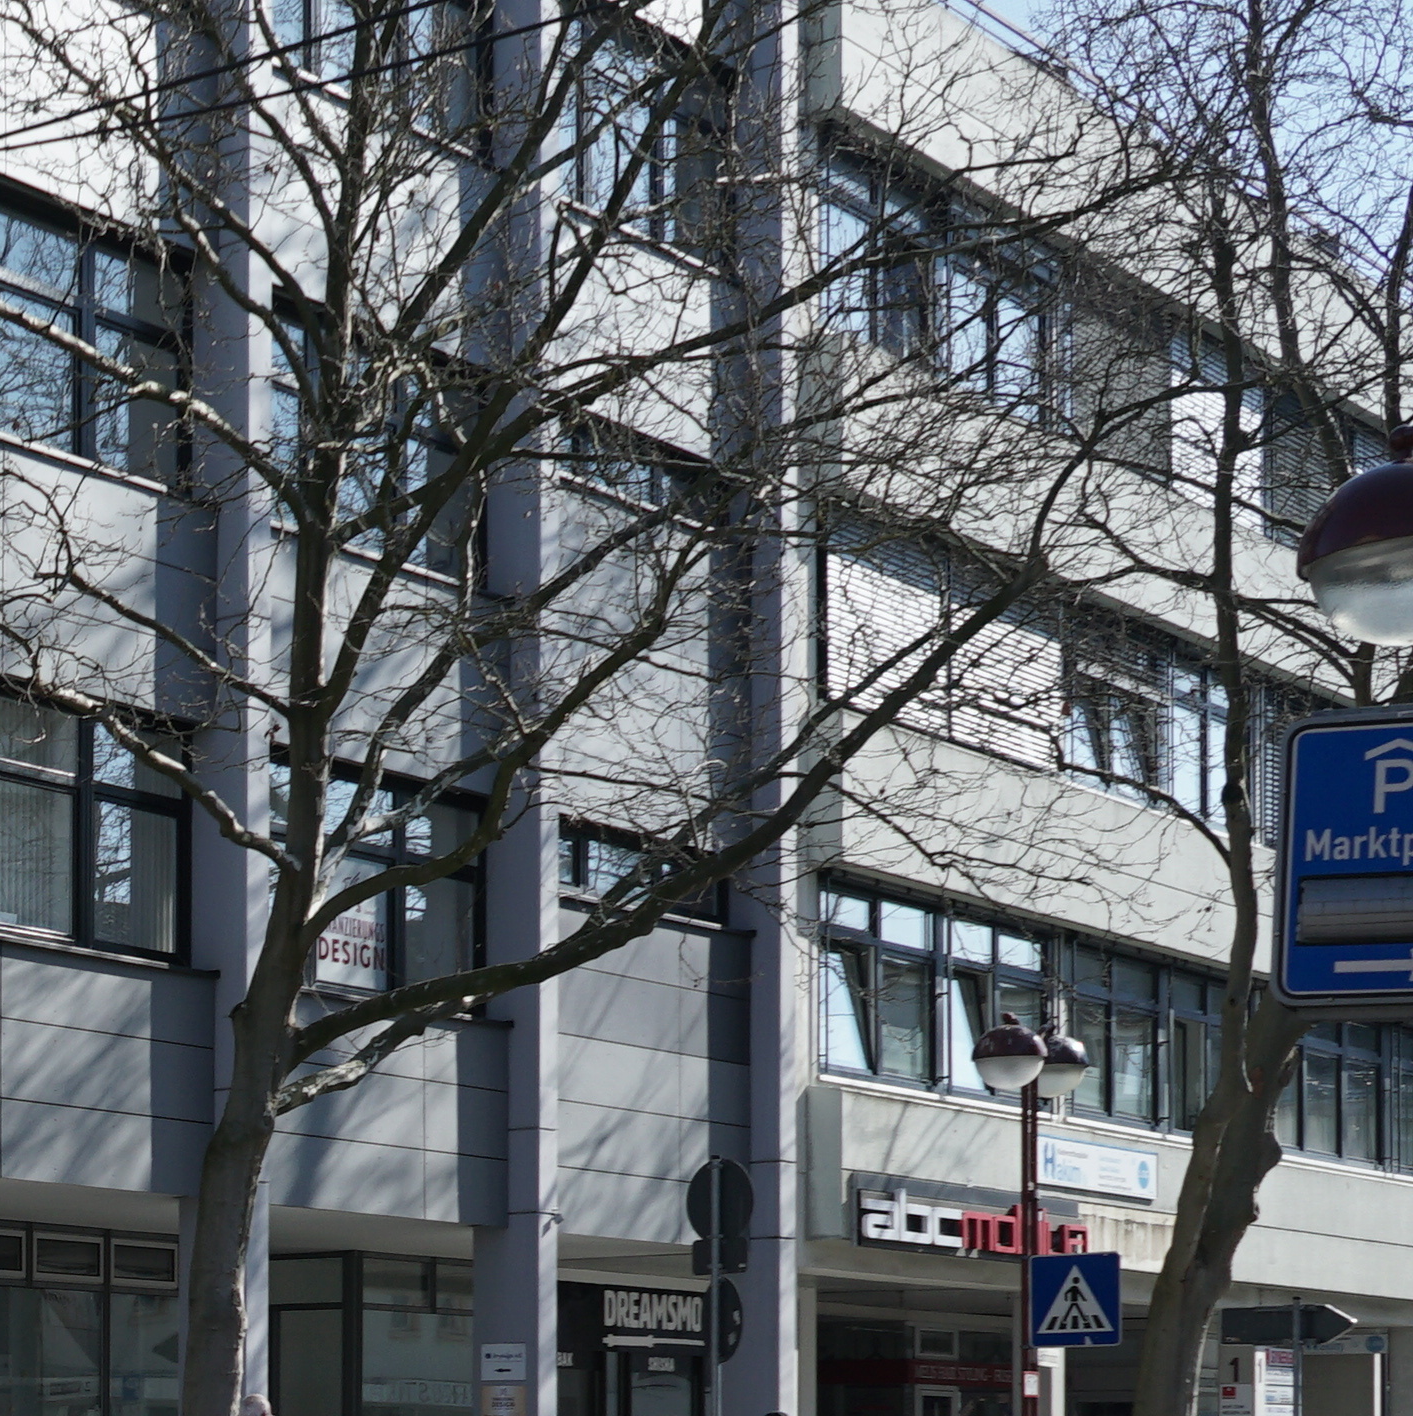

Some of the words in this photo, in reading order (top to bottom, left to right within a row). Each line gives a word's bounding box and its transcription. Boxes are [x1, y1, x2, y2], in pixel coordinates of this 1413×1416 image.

[1373, 759, 1413, 813] P
[318, 936, 385, 971] DESIGN
[861, 1188, 1088, 1254] abcmoile
[603, 1289, 704, 1333] DREAMSMO
[1229, 1357, 1239, 1382] 1
